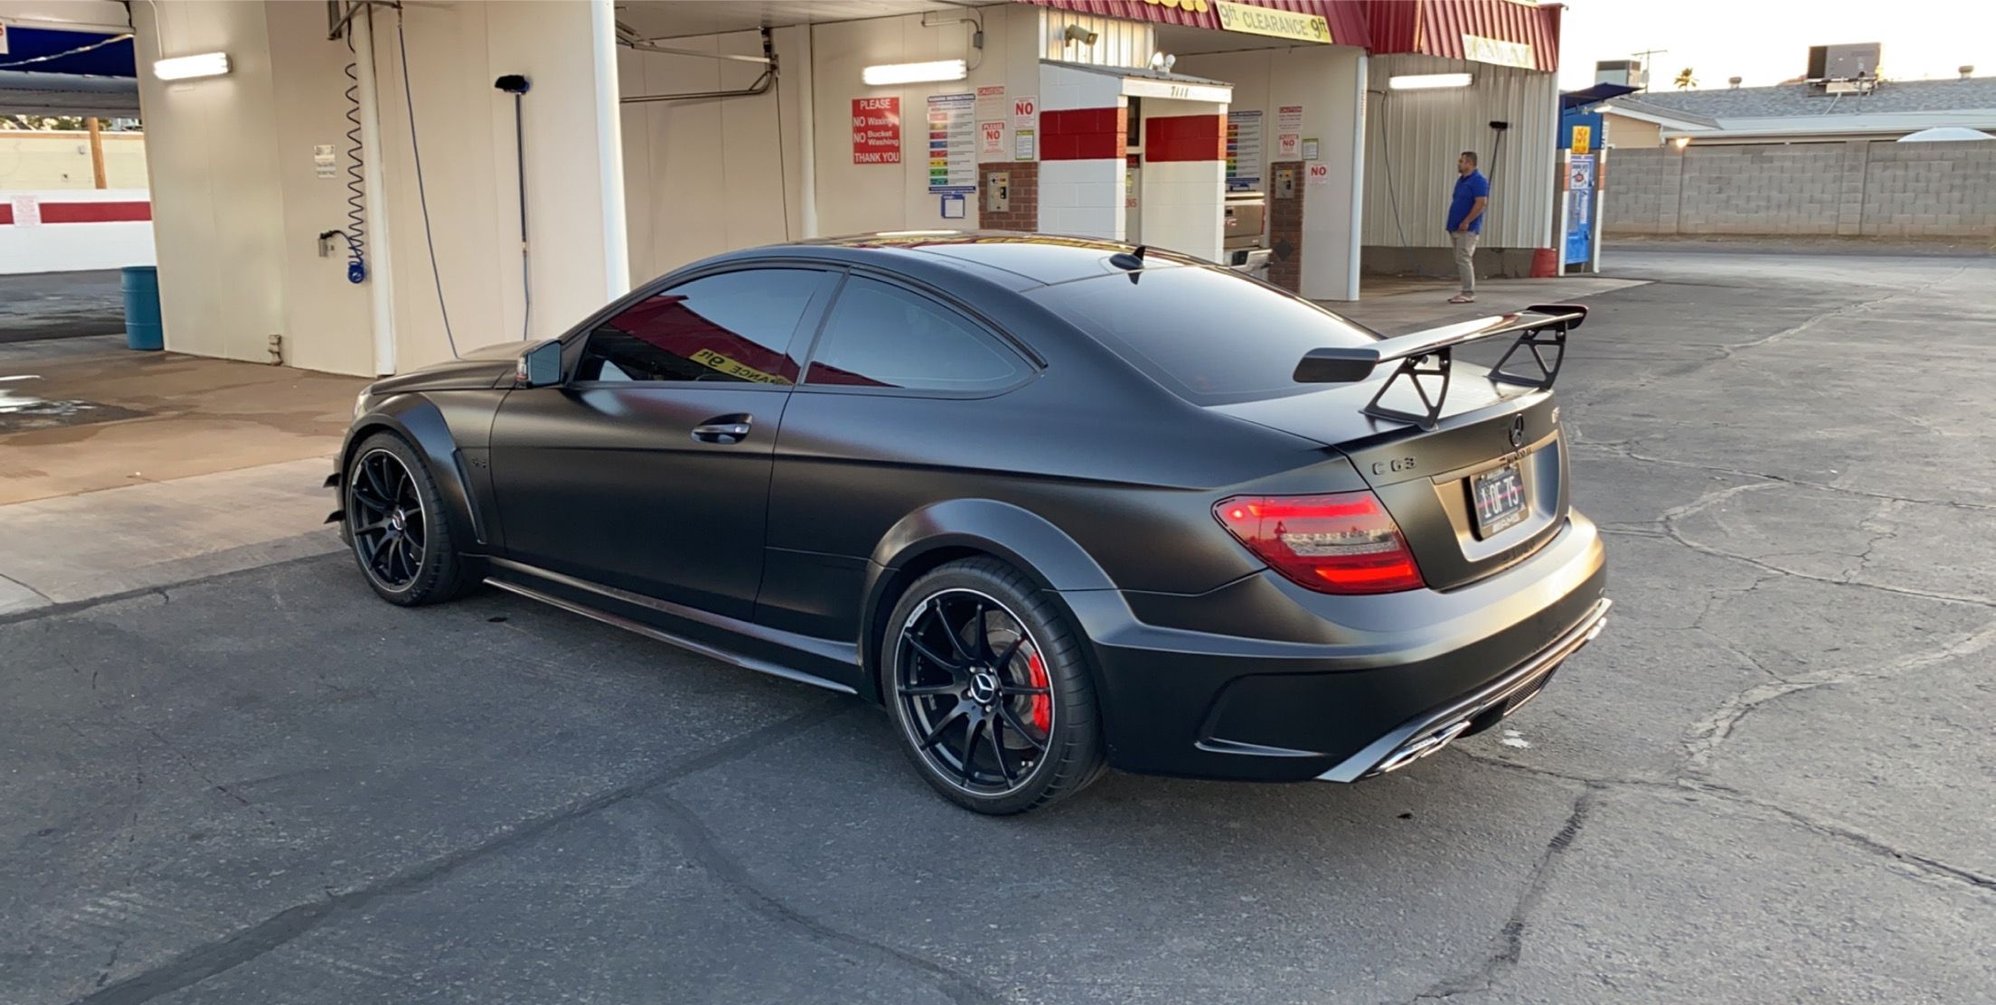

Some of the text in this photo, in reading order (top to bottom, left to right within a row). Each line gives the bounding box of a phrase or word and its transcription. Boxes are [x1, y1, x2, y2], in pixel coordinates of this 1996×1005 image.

[1220, 4, 1238, 27] 9ft
[1243, 11, 1308, 36] CLEARANCE
[1310, 18, 1328, 39] 9ft
[860, 99, 891, 110] PLEASE
[1015, 102, 1034, 116] NO
[853, 116, 866, 127] NO
[853, 130, 892, 144] NO Bucket
[986, 130, 1000, 140] NO
[867, 139, 899, 147] Washing
[1282, 139, 1296, 148] NO
[855, 151, 899, 163] THANK YOU
[1310, 166, 1327, 177] NO
[1481, 488, 1491, 518] 1
[1503, 475, 1519, 507] 75
